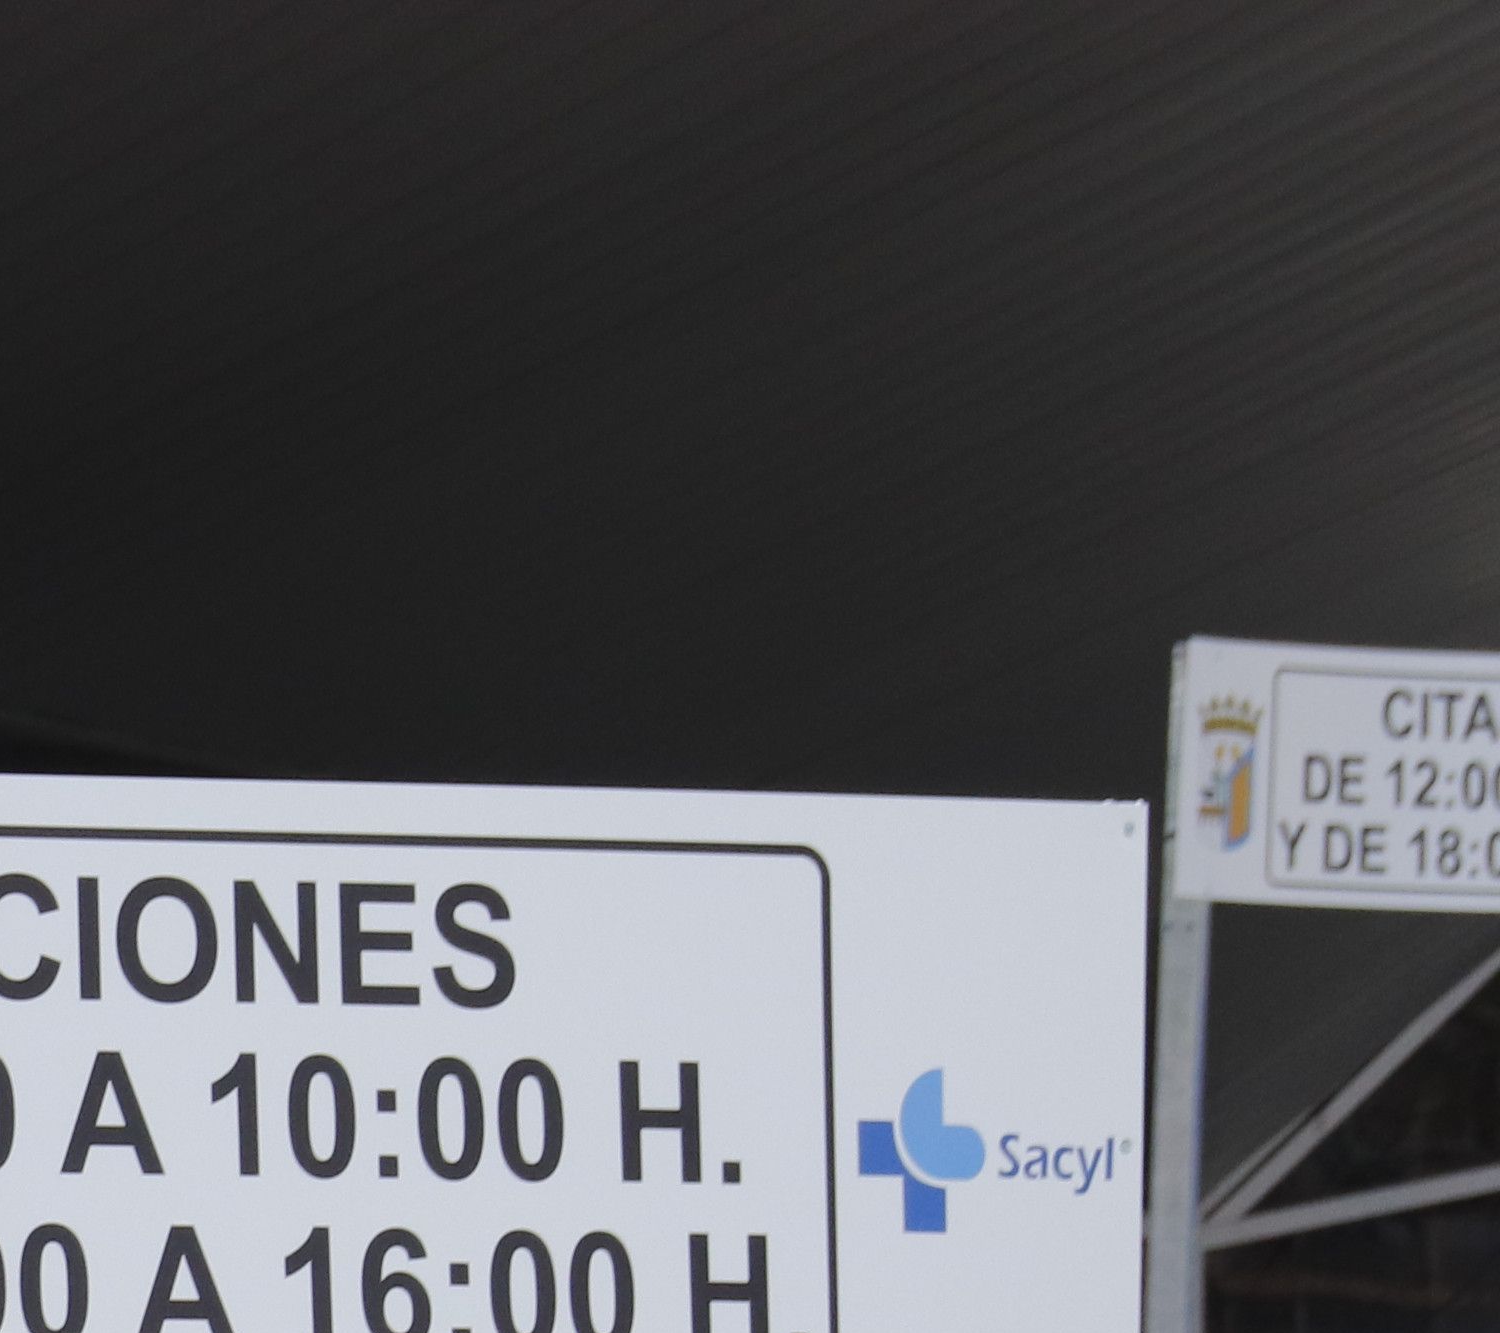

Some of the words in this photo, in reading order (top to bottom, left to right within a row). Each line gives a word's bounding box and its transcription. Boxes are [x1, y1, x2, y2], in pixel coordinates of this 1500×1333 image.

[1303, 754, 1365, 805] DE
[1279, 820, 1307, 873] Y
[1324, 822, 1388, 874] DE
[60, 1050, 165, 1175] A
[210, 1052, 565, 1183] 10:00
[618, 1060, 742, 1185] H.
[998, 1132, 1115, 1195] Sacyl
